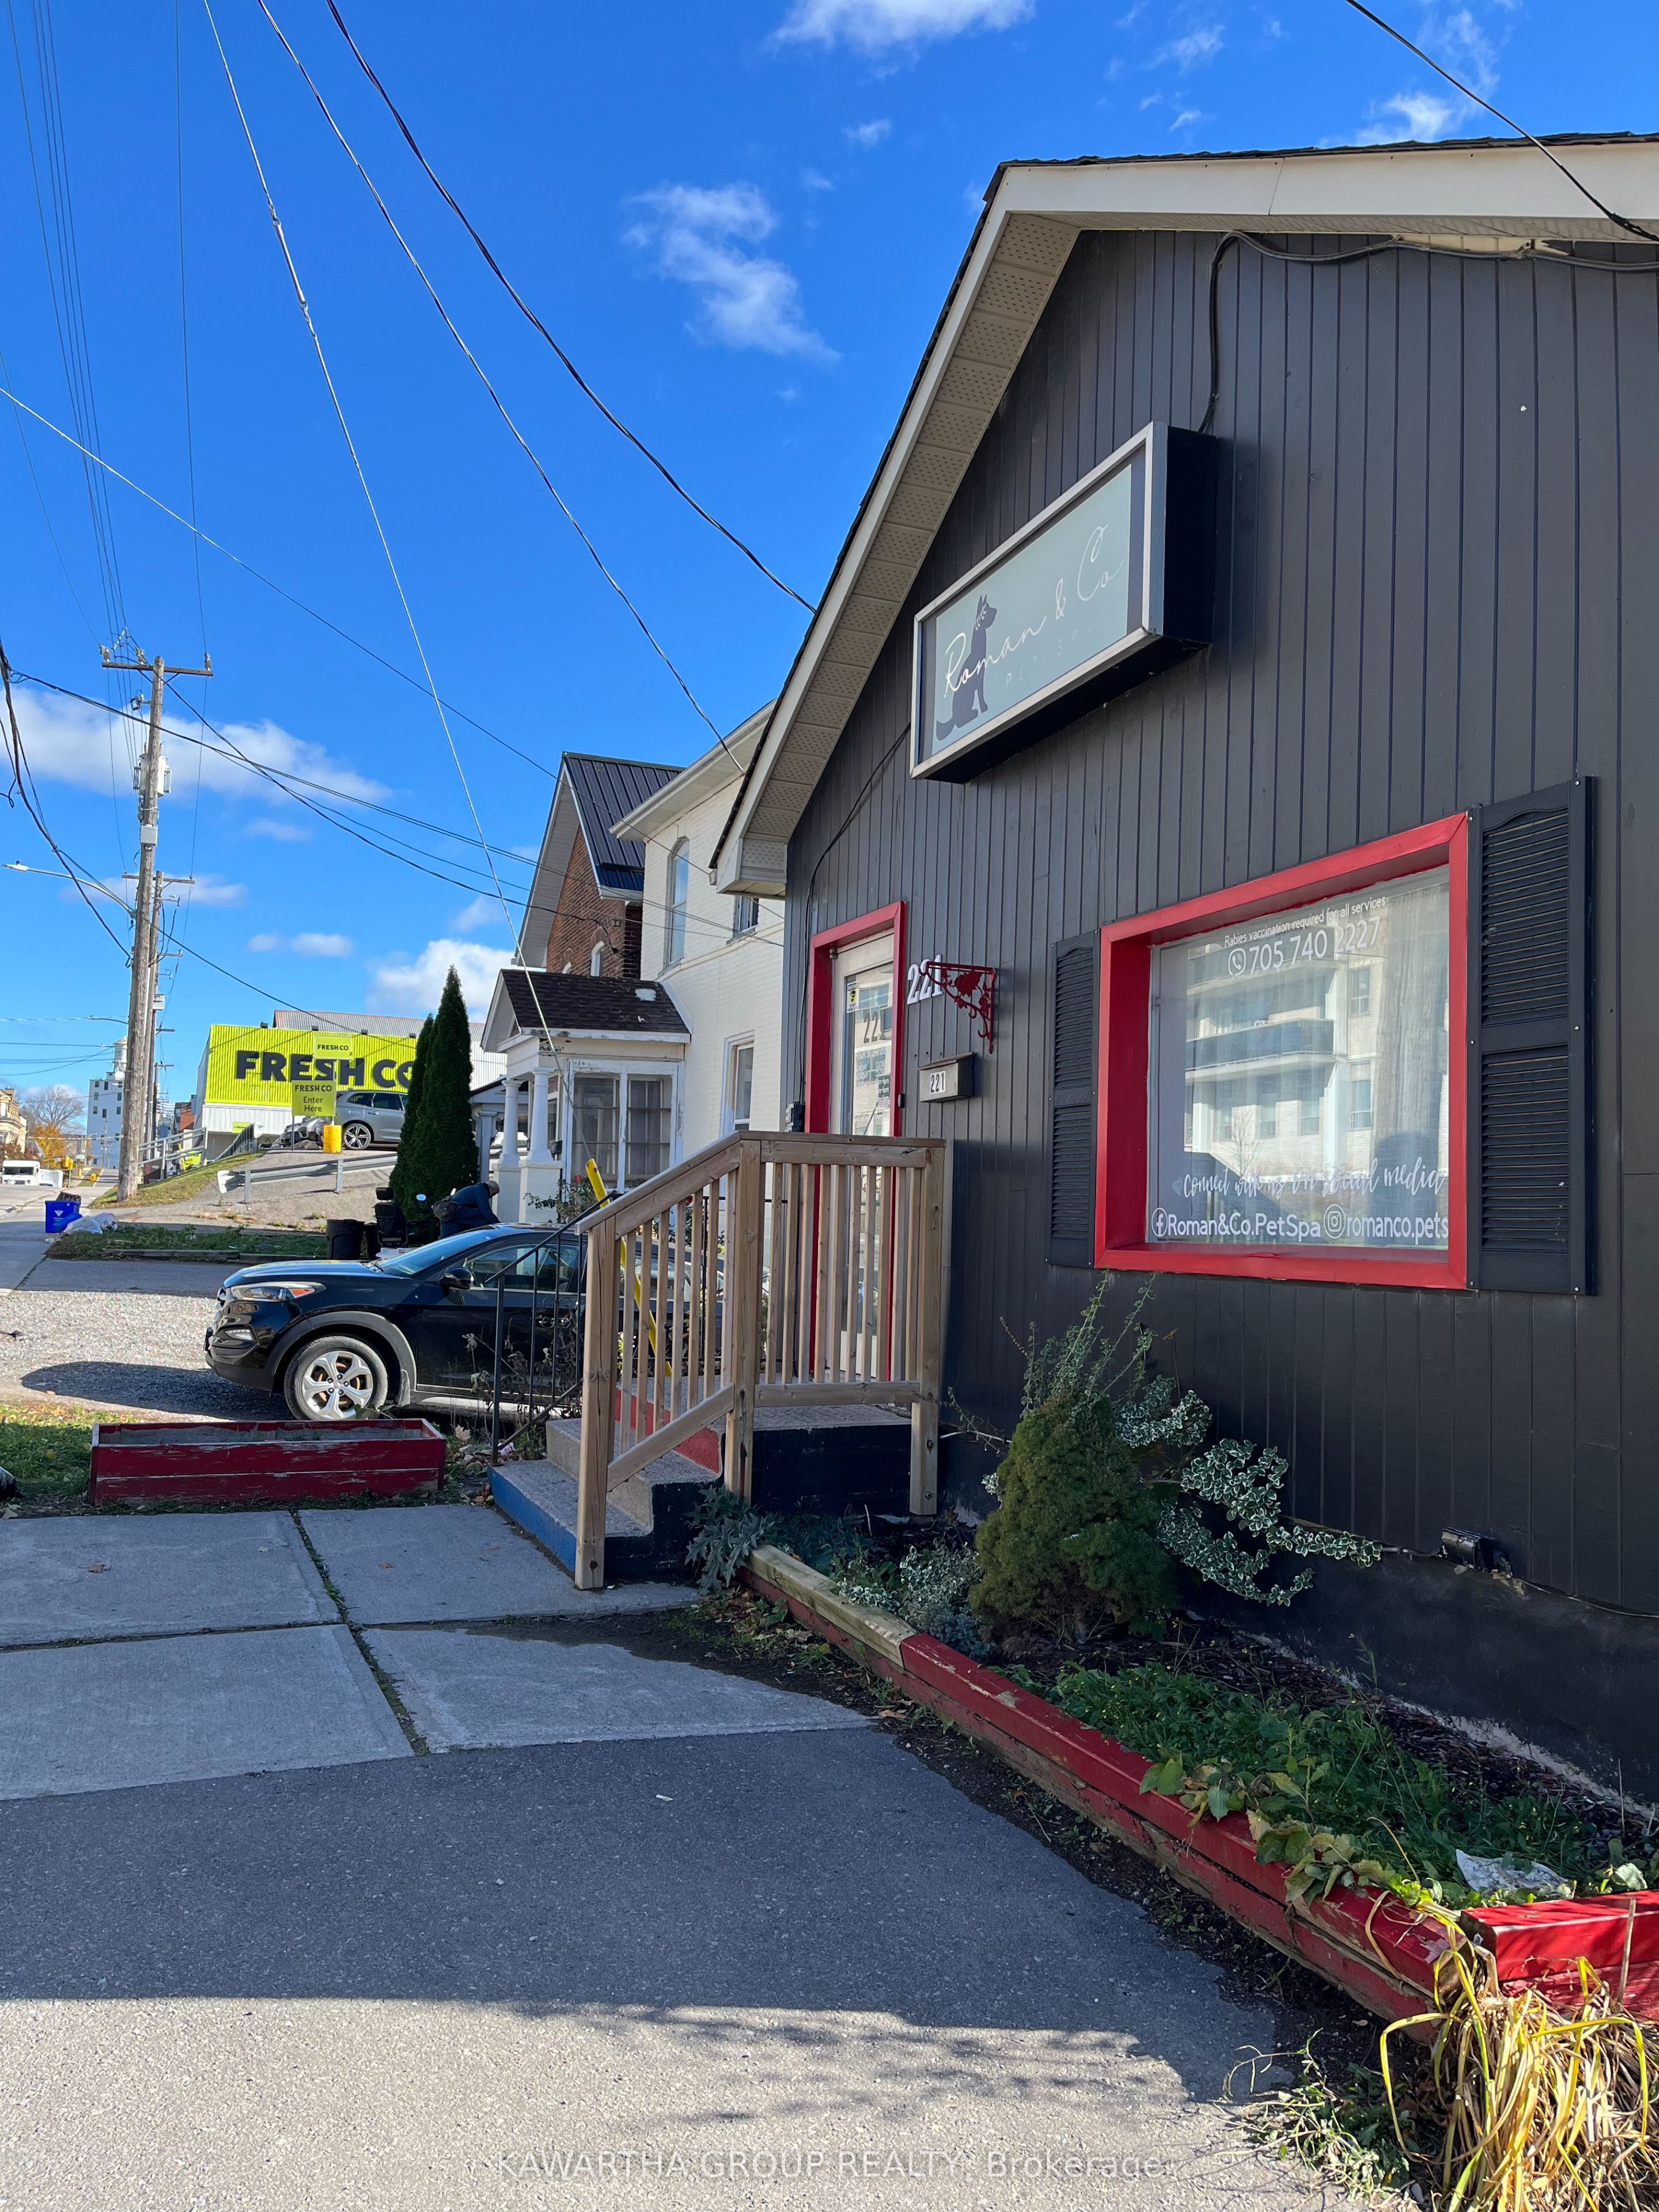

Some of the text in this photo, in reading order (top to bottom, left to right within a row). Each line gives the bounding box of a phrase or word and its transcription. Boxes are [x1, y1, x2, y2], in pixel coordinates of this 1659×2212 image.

[943, 524, 1125, 698] Roman & Co
[1006, 620, 1093, 688] PET SPA
[1224, 896, 1386, 947] Rabies vaccination required for all services
[1249, 915, 1381, 974] 705 740 2227
[907, 954, 944, 1005] 221
[234, 1050, 365, 1086] FRESH
[930, 1072, 945, 1093] 221
[304, 1104, 323, 1112] Here
[1384, 1156, 1445, 1195] media
[1346, 1211, 1449, 1245] romanco.pets
